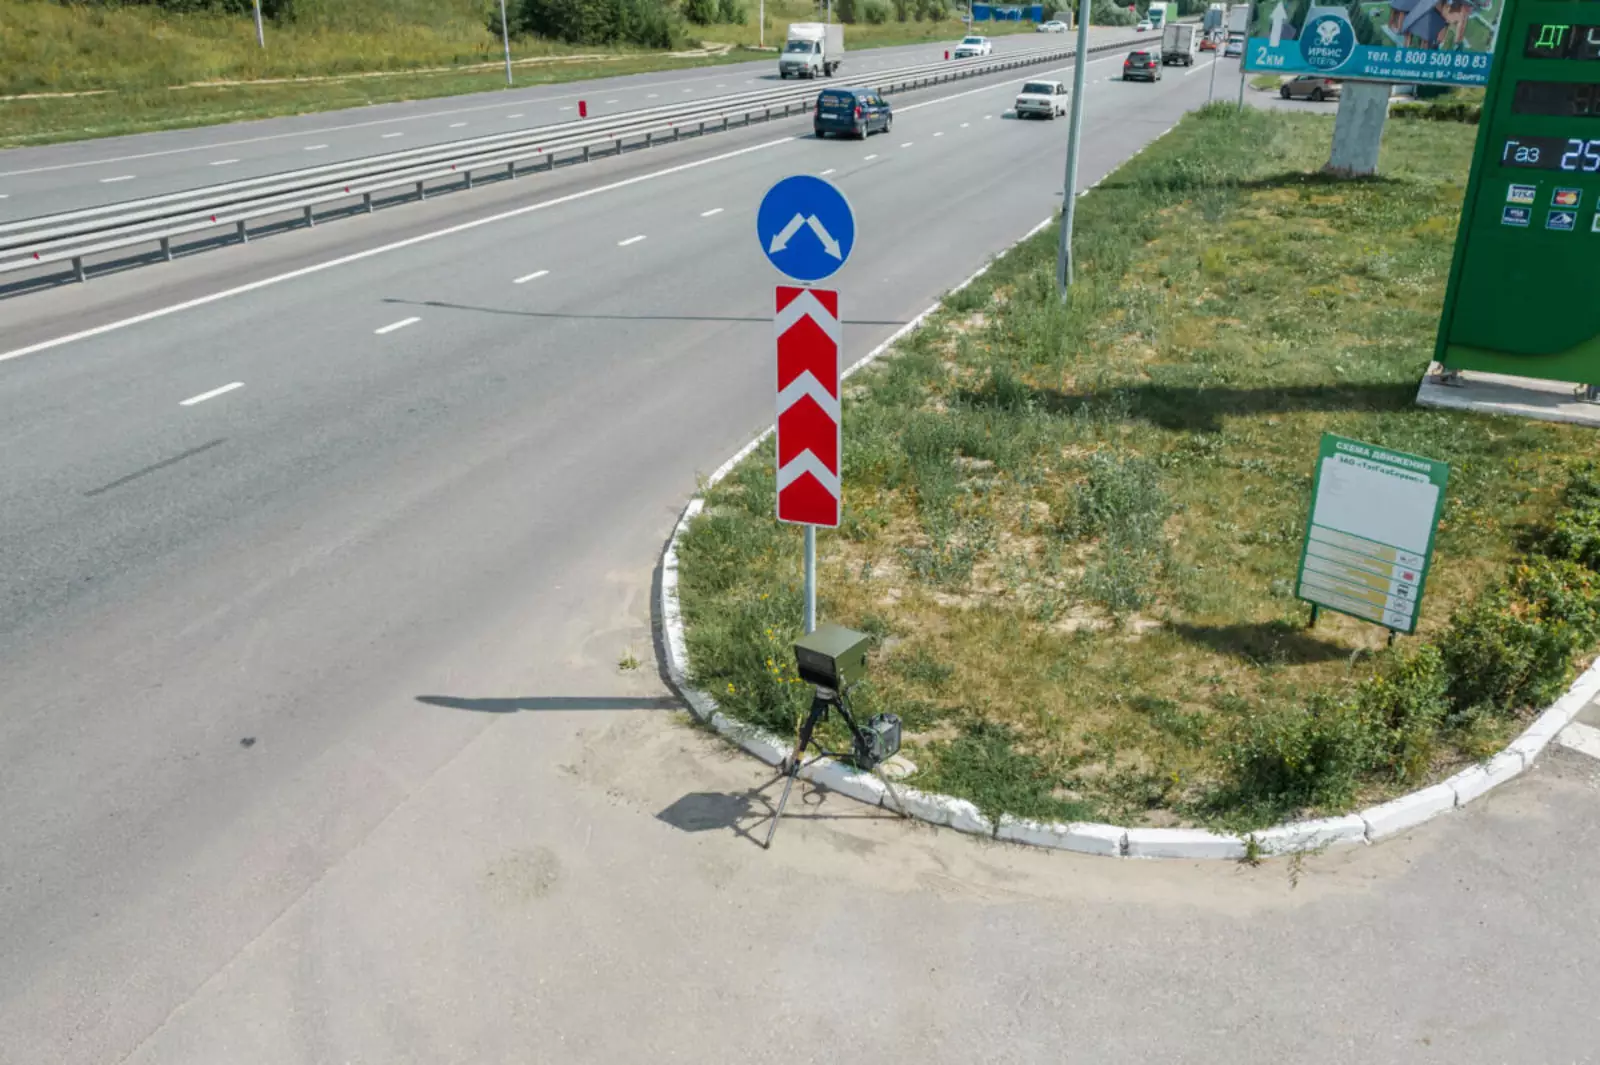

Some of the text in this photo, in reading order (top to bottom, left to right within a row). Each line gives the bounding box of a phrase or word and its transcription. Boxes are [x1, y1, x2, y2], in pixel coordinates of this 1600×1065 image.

[1535, 24, 1570, 49] ДТ
[1308, 46, 1342, 57] ИРБИС
[1367, 50, 1488, 69] тел. 8 800 500 80 83
[1503, 141, 1540, 163] Газ
[1512, 190, 1535, 199] VISA
[1336, 441, 1432, 473] СХЕМА ДВИЖЕНИЯ
